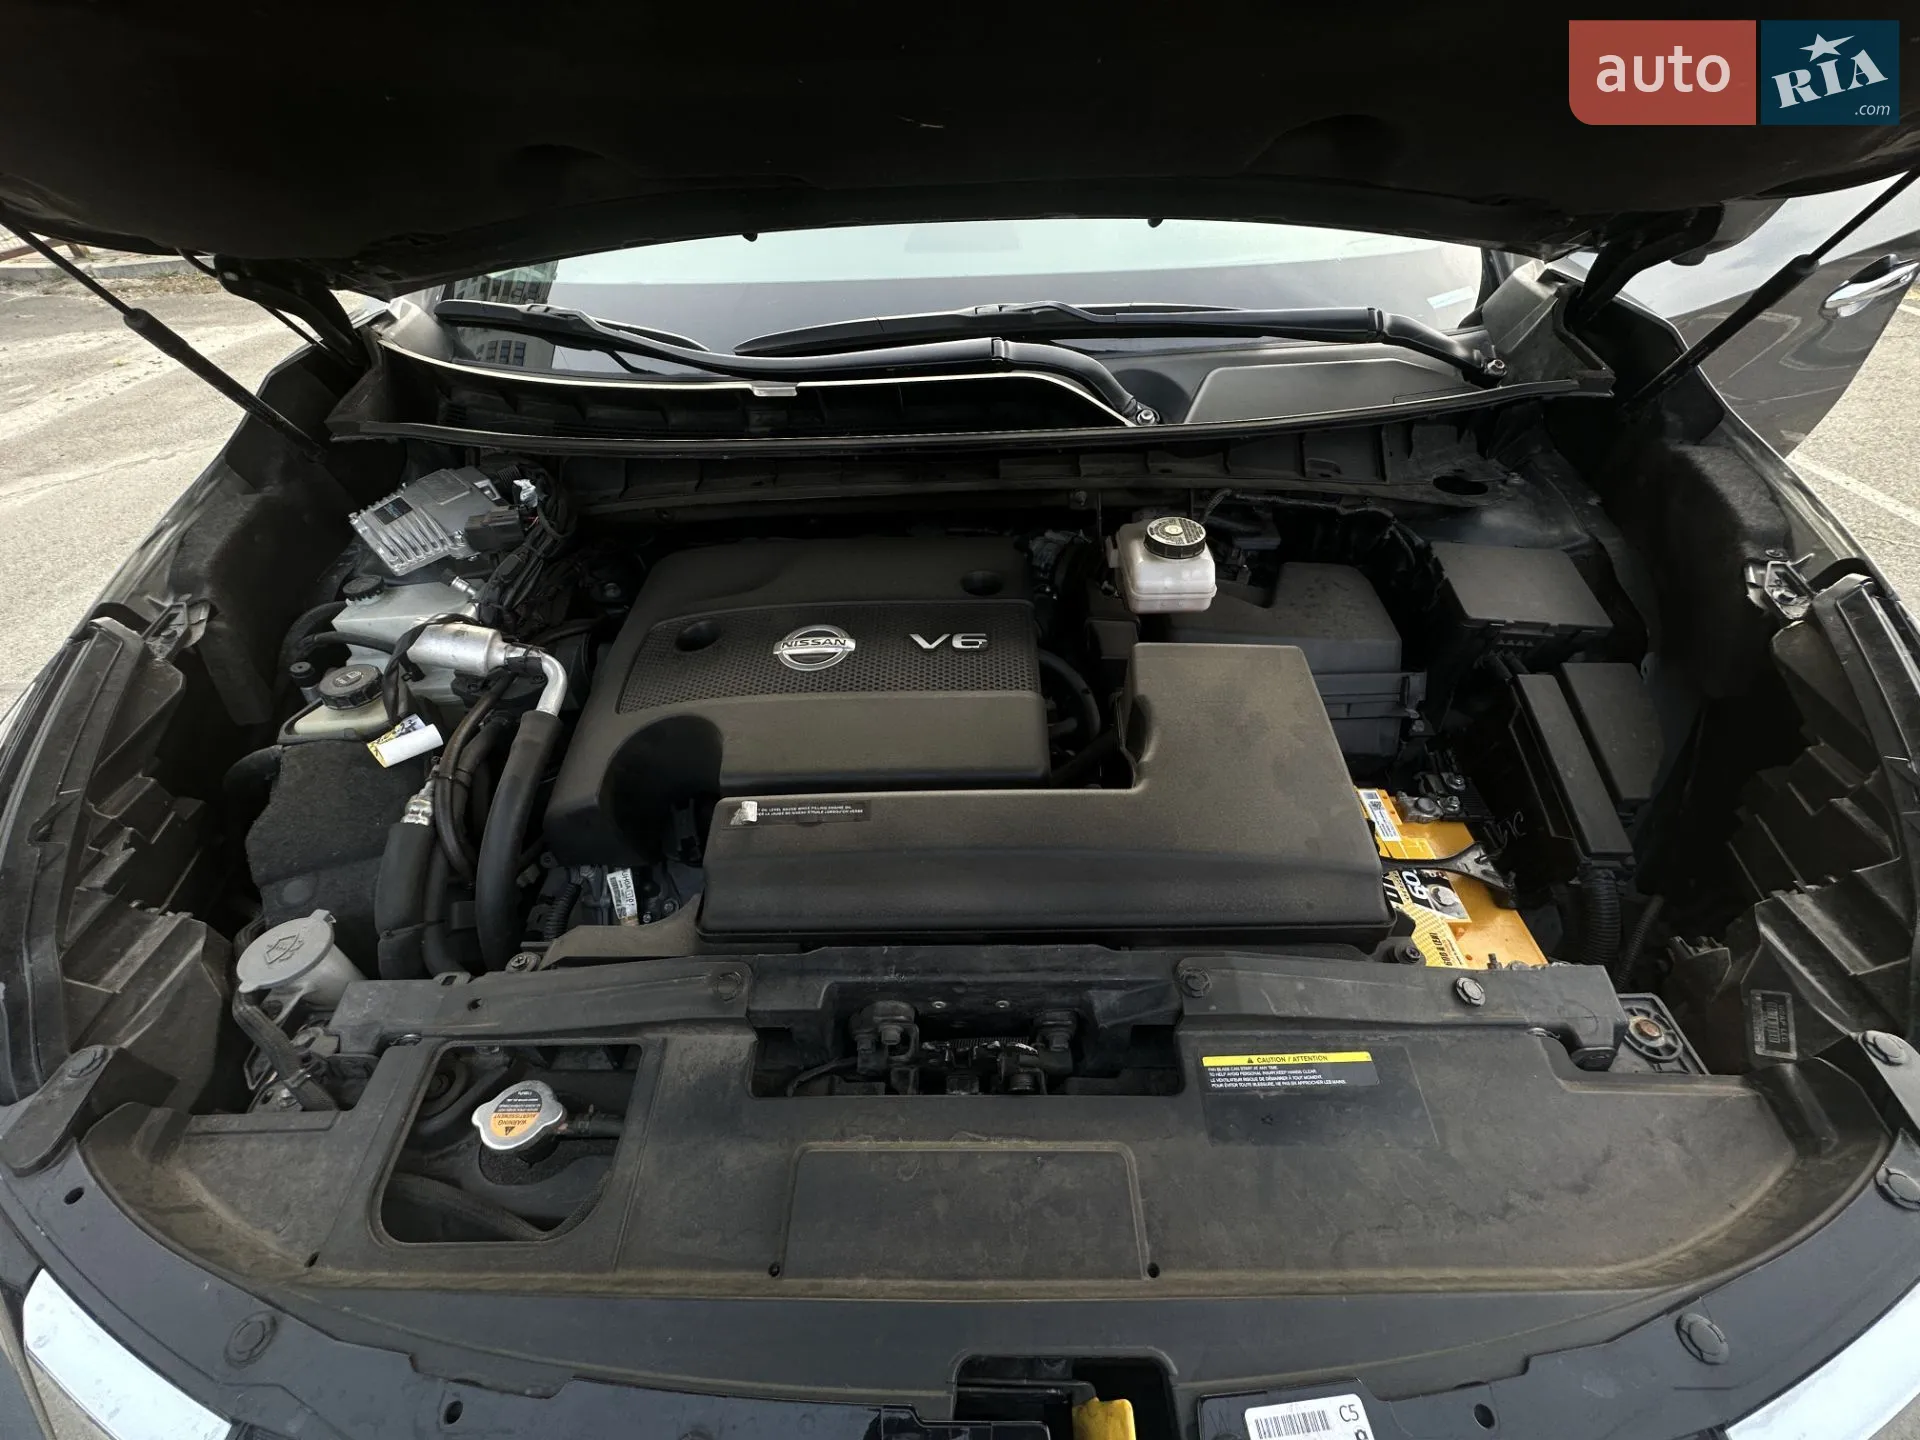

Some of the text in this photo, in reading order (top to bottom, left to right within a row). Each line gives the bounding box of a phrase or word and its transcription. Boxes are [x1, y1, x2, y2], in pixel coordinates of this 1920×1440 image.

[782, 639, 847, 649] NISSAN
[908, 633, 988, 650] V6
[1339, 1404, 1360, 1422] C5
